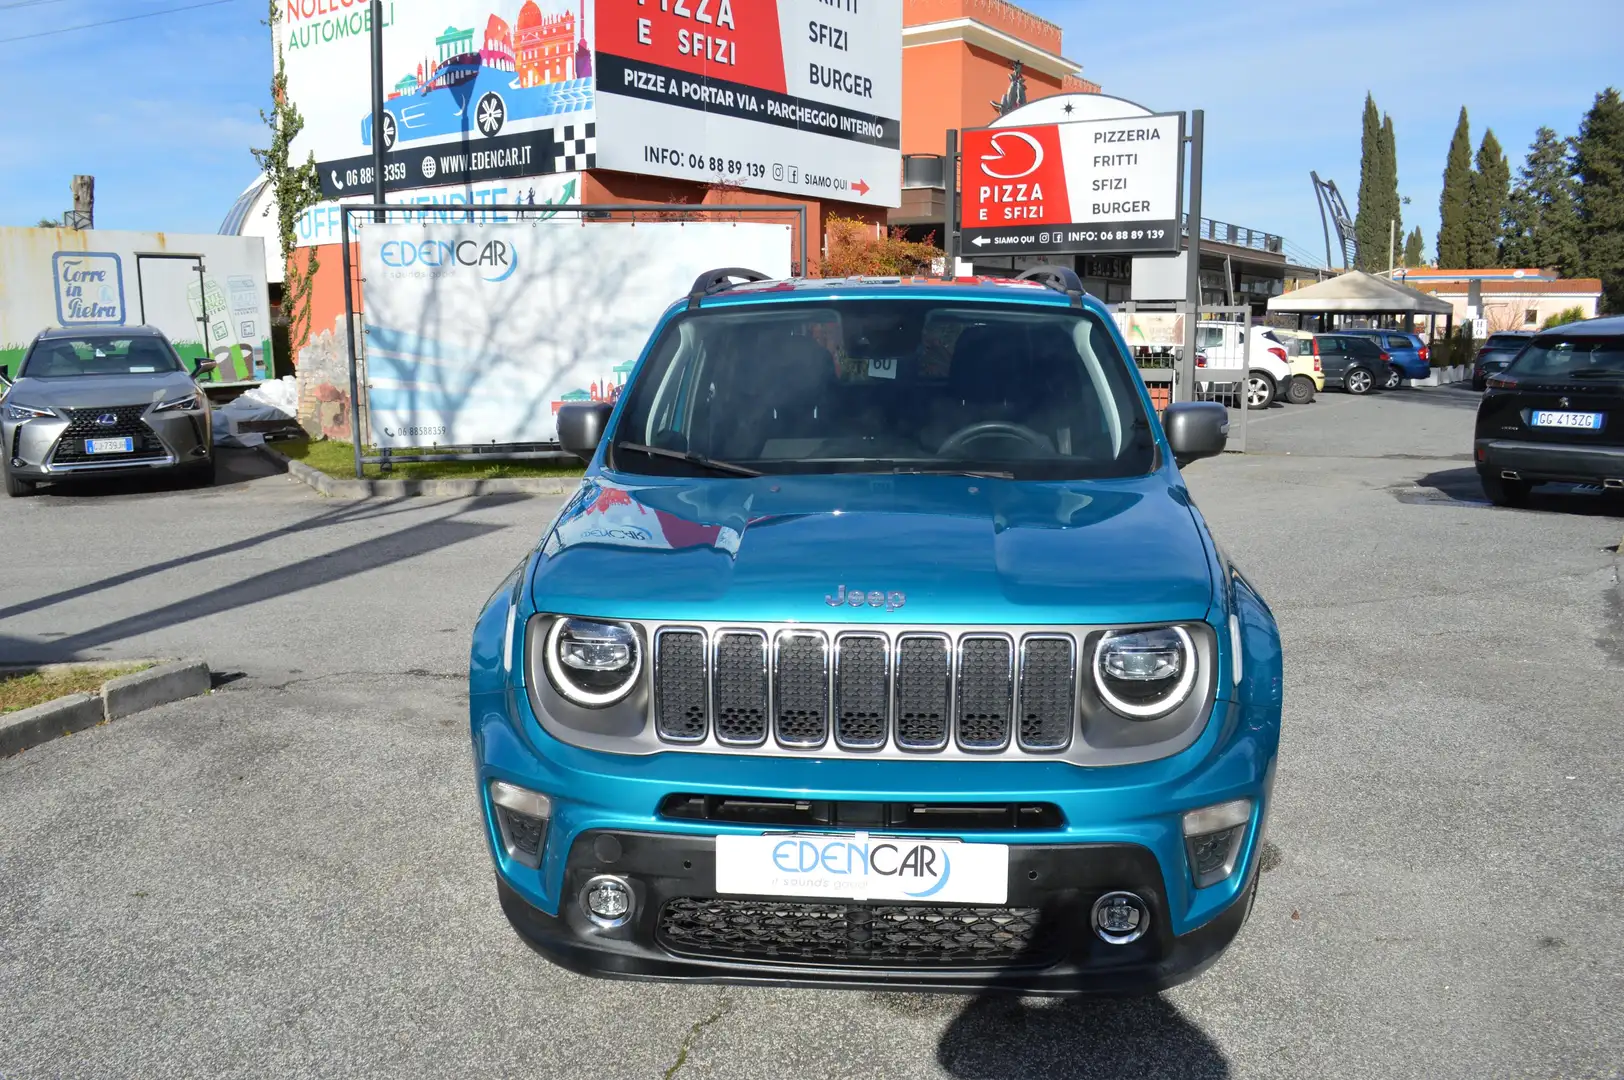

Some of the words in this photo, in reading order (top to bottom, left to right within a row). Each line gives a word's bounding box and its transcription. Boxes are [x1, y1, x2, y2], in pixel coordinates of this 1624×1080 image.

[638, 17, 652, 45] E
[678, 28, 736, 66] SFIZI
[808, 20, 848, 52] SFIZI
[809, 63, 873, 98] BURGER
[624, 68, 665, 93] PIZZE
[668, 79, 679, 96] A
[682, 82, 734, 108] PORTAR
[736, 92, 758, 113] VIA
[767, 99, 838, 129] PARCHEGGIO
[840, 116, 884, 139] INTERNO
[1094, 127, 1161, 144] PIZZERIA
[346, 169, 358, 187] 06
[440, 145, 532, 174] WWW.EDENCAR.IT
[644, 145, 685, 167] INFO:
[688, 153, 705, 170] 06
[709, 156, 724, 172] 88
[728, 160, 742, 175] 89
[746, 162, 766, 178] 139
[804, 173, 832, 188] SIAMO
[833, 177, 848, 190] QUI
[1093, 153, 1138, 168] FRITTI
[979, 182, 1044, 204] PIZZA
[1092, 177, 1127, 191] SFIZI
[979, 208, 988, 221] E
[1003, 205, 1044, 220] SFIZI
[1092, 200, 1151, 215] BURGER
[994, 236, 1020, 245] SIAMO
[1020, 235, 1035, 246] QUI
[1068, 231, 1098, 243] INFO:
[1100, 231, 1113, 241] 06
[1115, 230, 1129, 240] 88
[1131, 230, 1144, 240] 89
[1146, 229, 1165, 240] 139
[380, 239, 509, 267] EDENCAR
[63, 260, 106, 282] Torre
[65, 282, 83, 297] in
[68, 297, 117, 319] Pietra
[1539, 413, 1554, 425] GG
[397, 427, 408, 437] 06
[409, 425, 446, 436] 88588359
[825, 584, 907, 612] Jeep
[772, 840, 938, 877] EDENCAR
